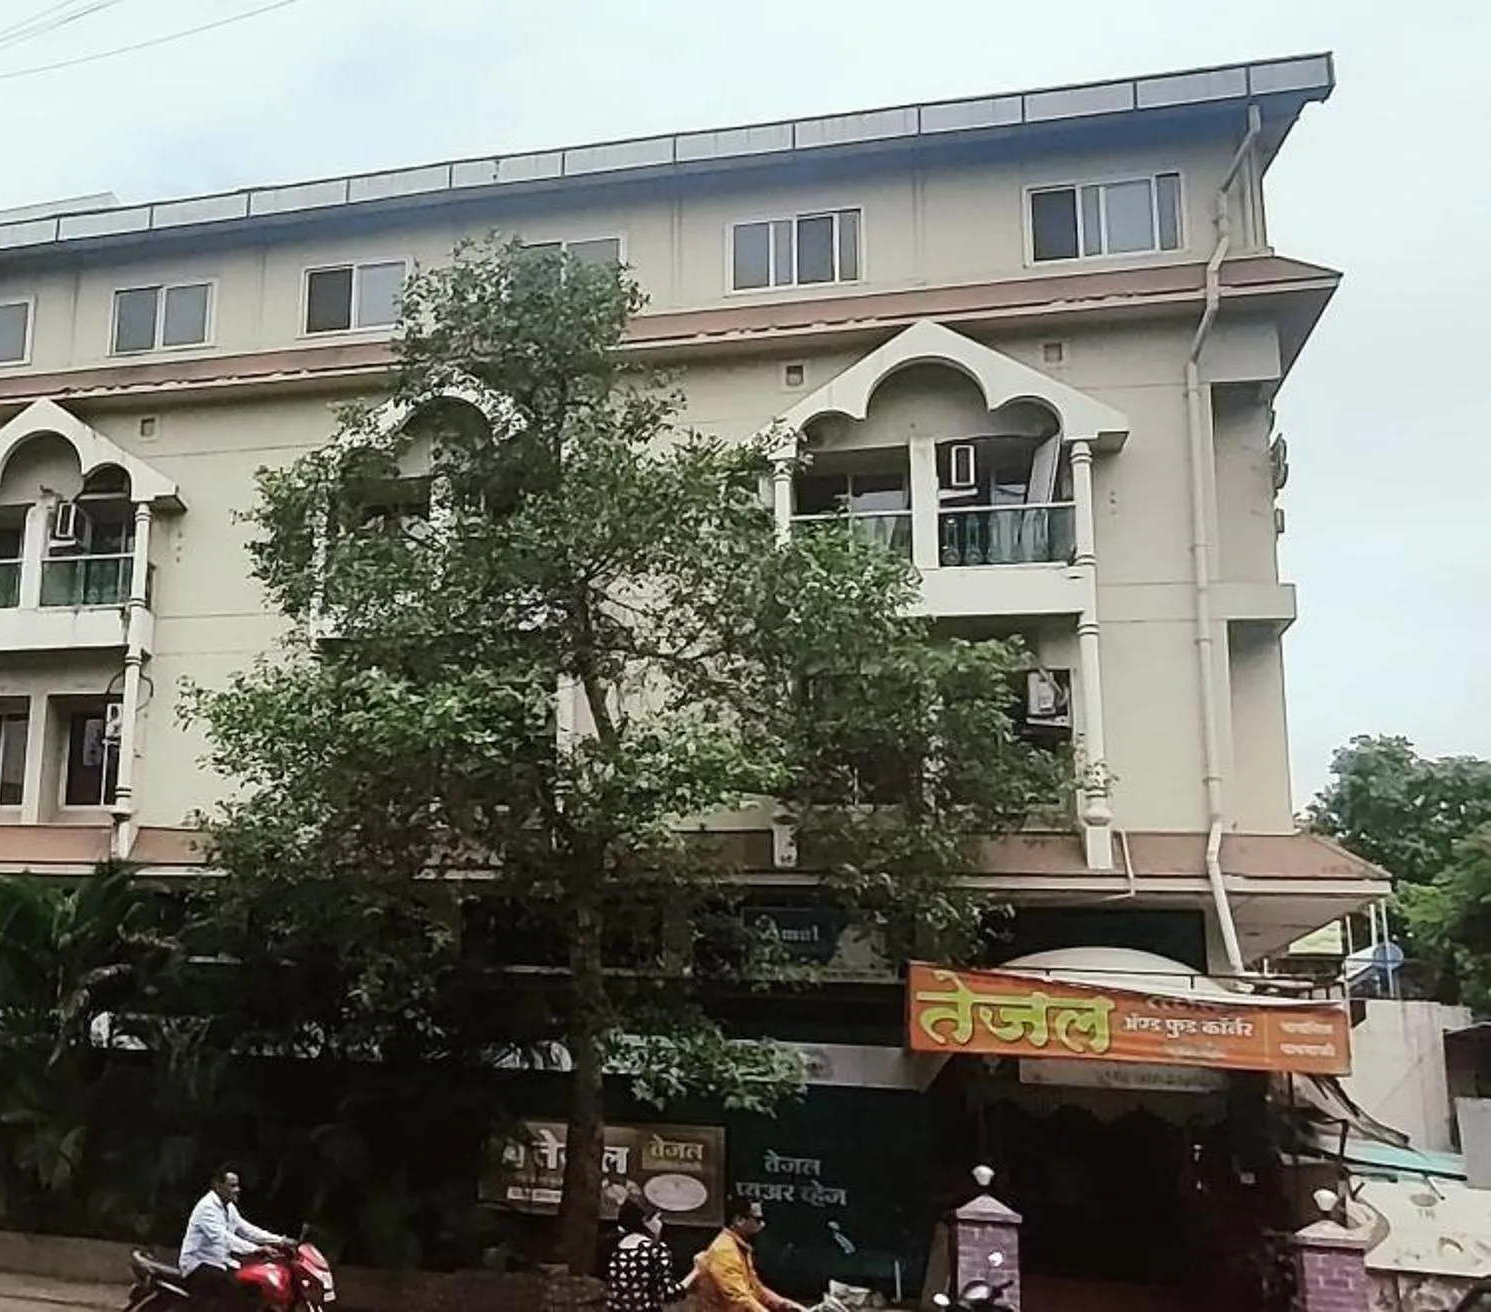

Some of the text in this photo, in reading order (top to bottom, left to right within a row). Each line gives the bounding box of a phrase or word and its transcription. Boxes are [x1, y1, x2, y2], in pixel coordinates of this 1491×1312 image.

[916, 970, 1115, 1054] तेजल
[649, 1134, 703, 1161] तेजल
[763, 1149, 821, 1176] तेजल
